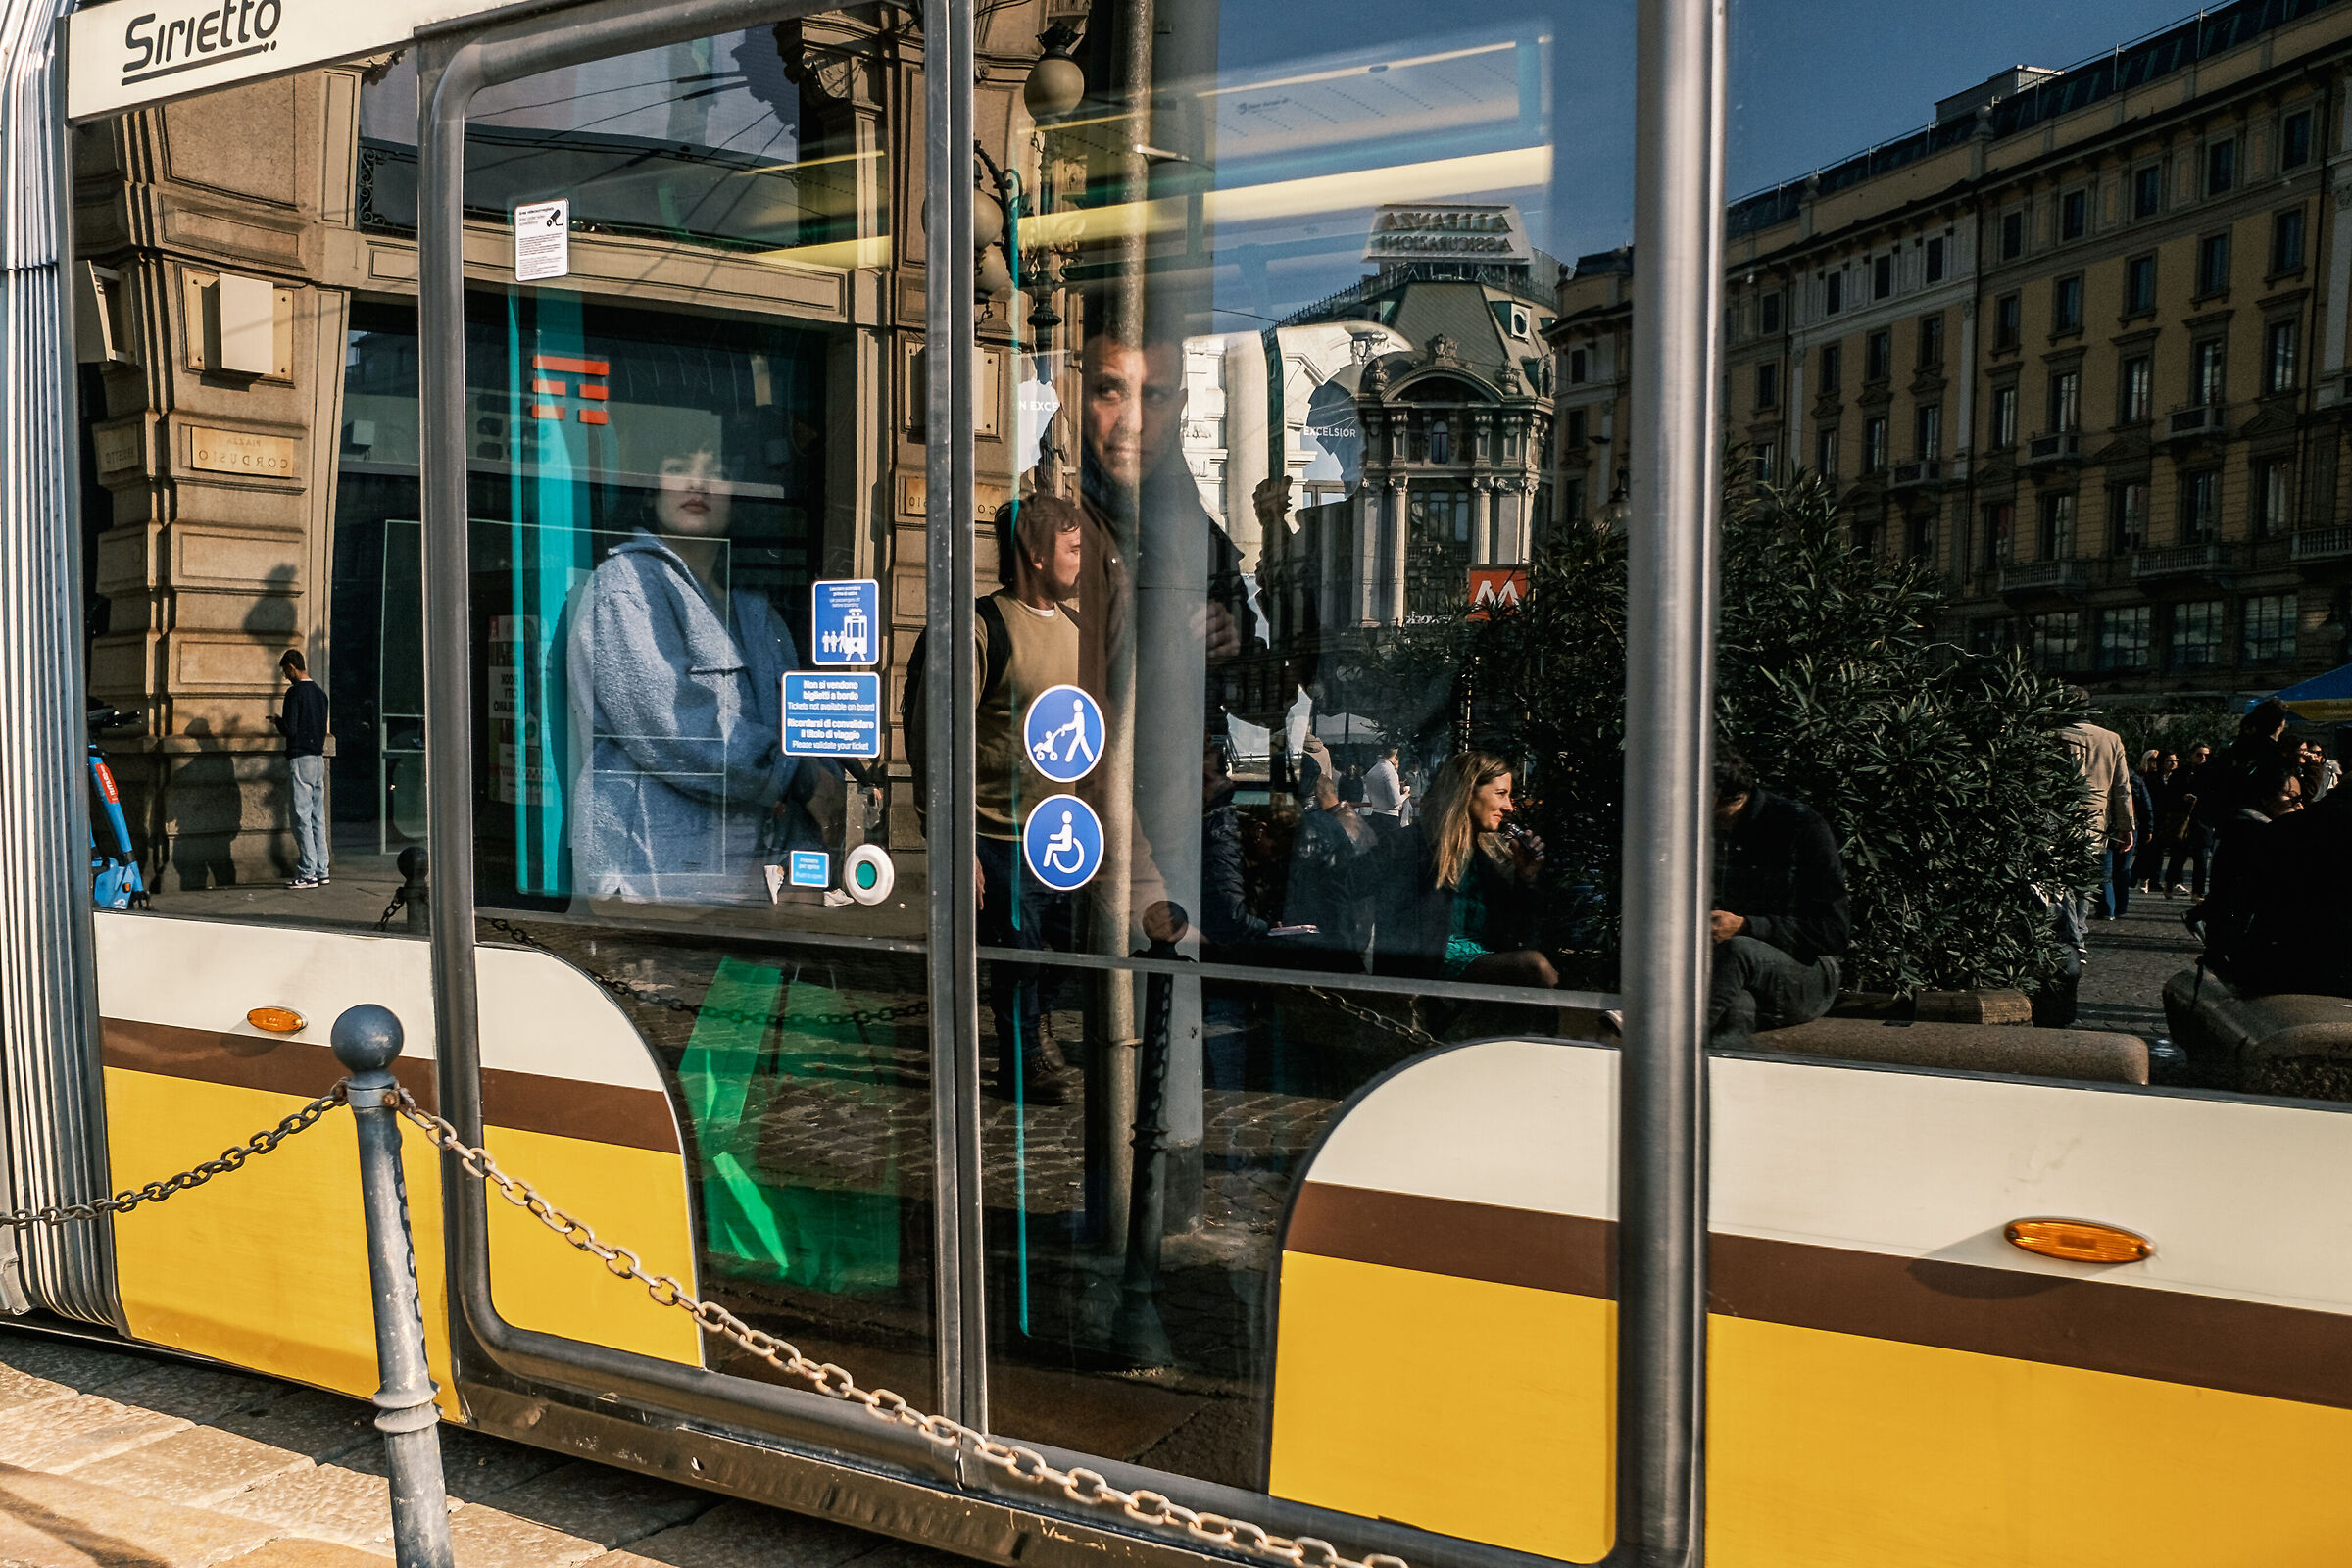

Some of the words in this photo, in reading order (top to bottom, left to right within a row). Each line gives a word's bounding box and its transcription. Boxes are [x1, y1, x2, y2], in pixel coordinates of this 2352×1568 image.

[123, 0, 281, 73] Sirietto
[1303, 426, 1356, 438] EXCELSIOR
[804, 680, 818, 689] Non
[818, 680, 826, 689] si
[826, 680, 858, 690] vendono
[803, 690, 830, 702] biglietti
[837, 691, 859, 701] bordo
[788, 701, 809, 710] Tickets
[787, 718, 823, 727] Ricordarsi
[824, 718, 831, 727] di
[832, 719, 874, 729] convalidare
[807, 729, 825, 738] titolo
[825, 729, 833, 738] di
[834, 730, 860, 741] viaggio
[792, 740, 812, 749] Please
[852, 742, 869, 751] ticket
